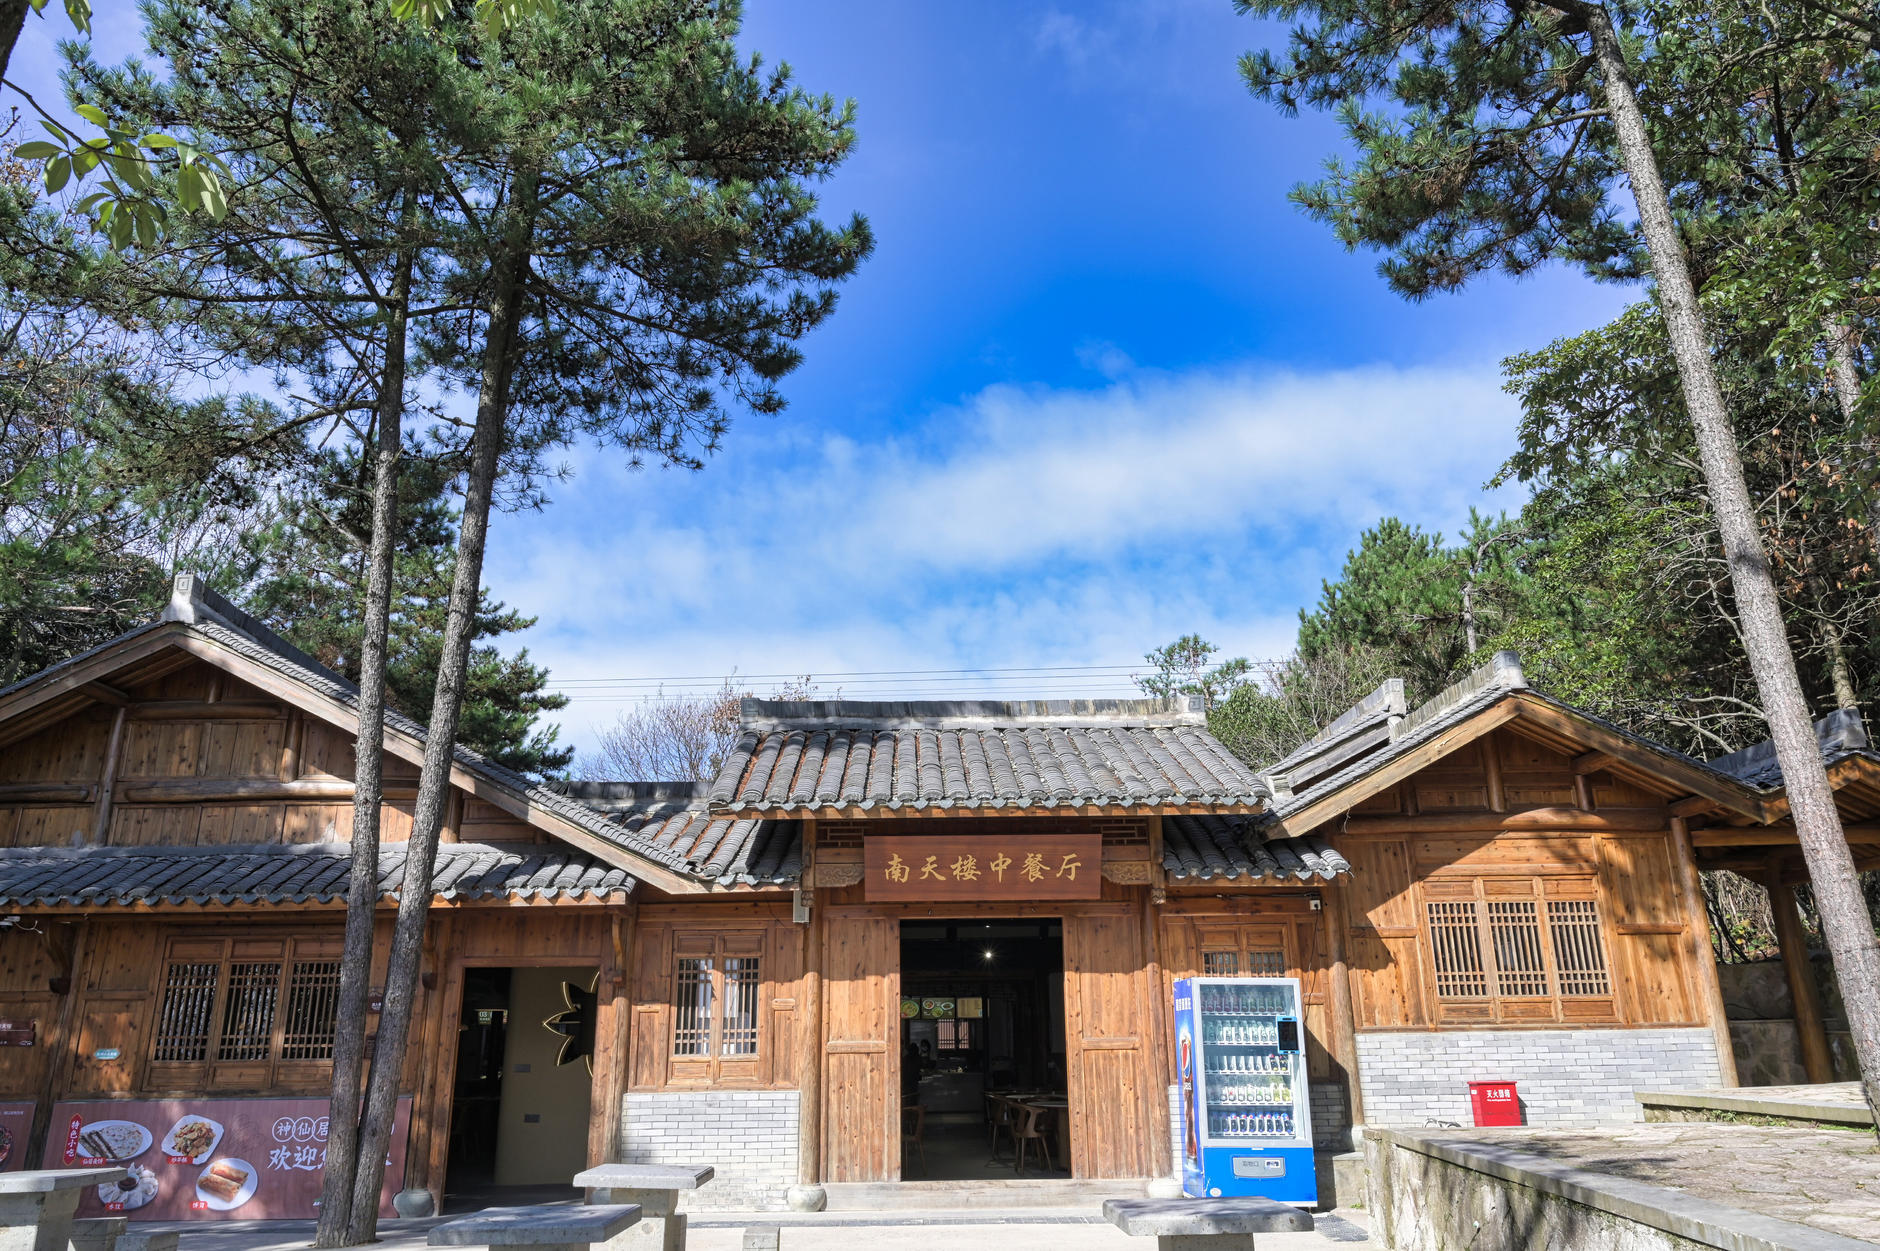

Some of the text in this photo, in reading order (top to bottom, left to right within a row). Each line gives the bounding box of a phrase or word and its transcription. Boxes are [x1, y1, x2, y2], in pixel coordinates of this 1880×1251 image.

[884, 852, 1082, 883] 南天楼中餐厅
[66, 1120, 80, 1157] 特色小吃
